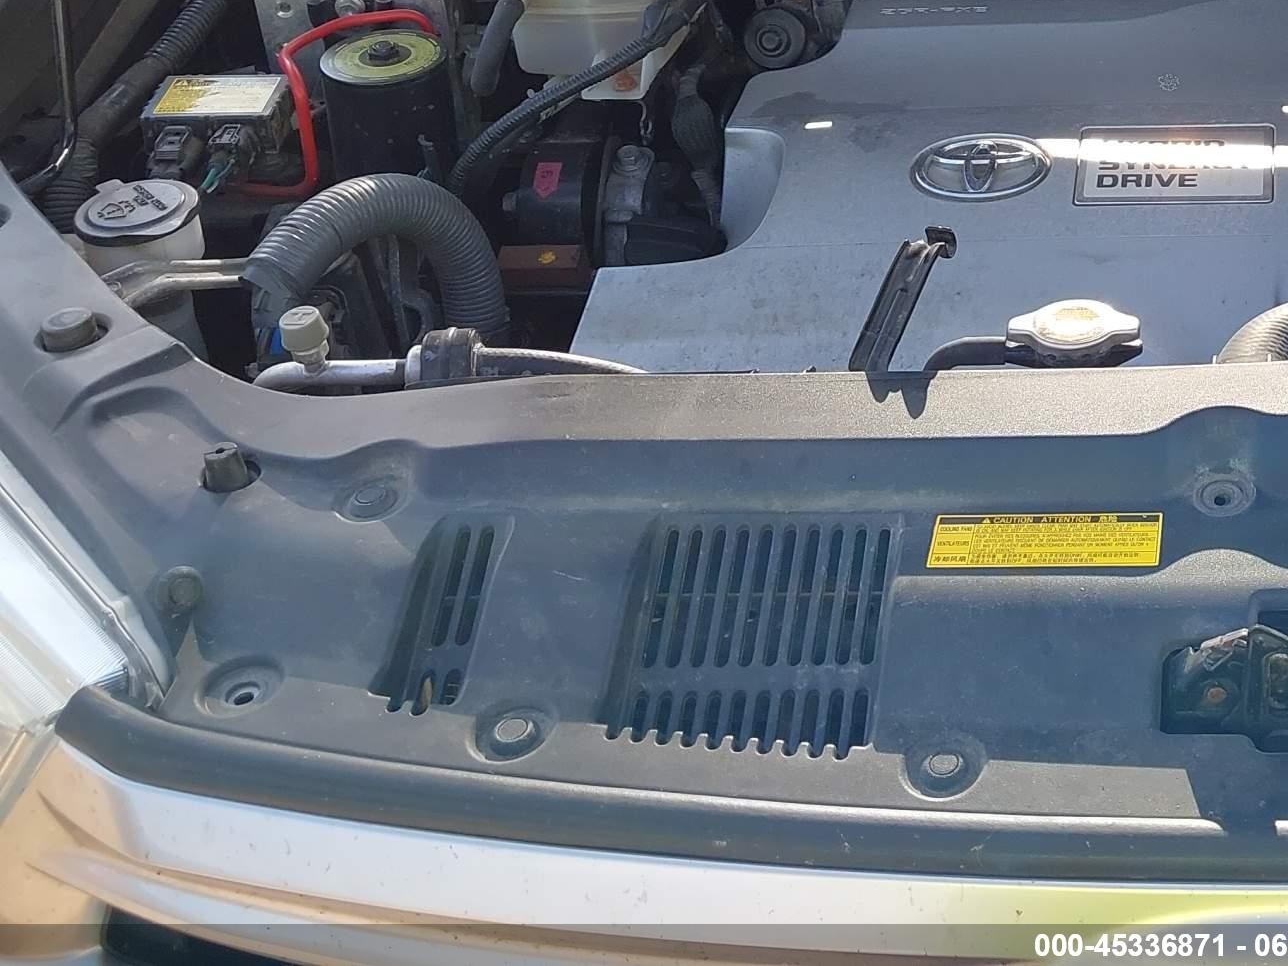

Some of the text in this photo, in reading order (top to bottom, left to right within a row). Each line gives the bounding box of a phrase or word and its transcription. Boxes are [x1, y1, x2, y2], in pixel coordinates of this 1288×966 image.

[1096, 173, 1198, 188] DRIVE
[993, 515, 1092, 524] CAUTION ATTENTION
